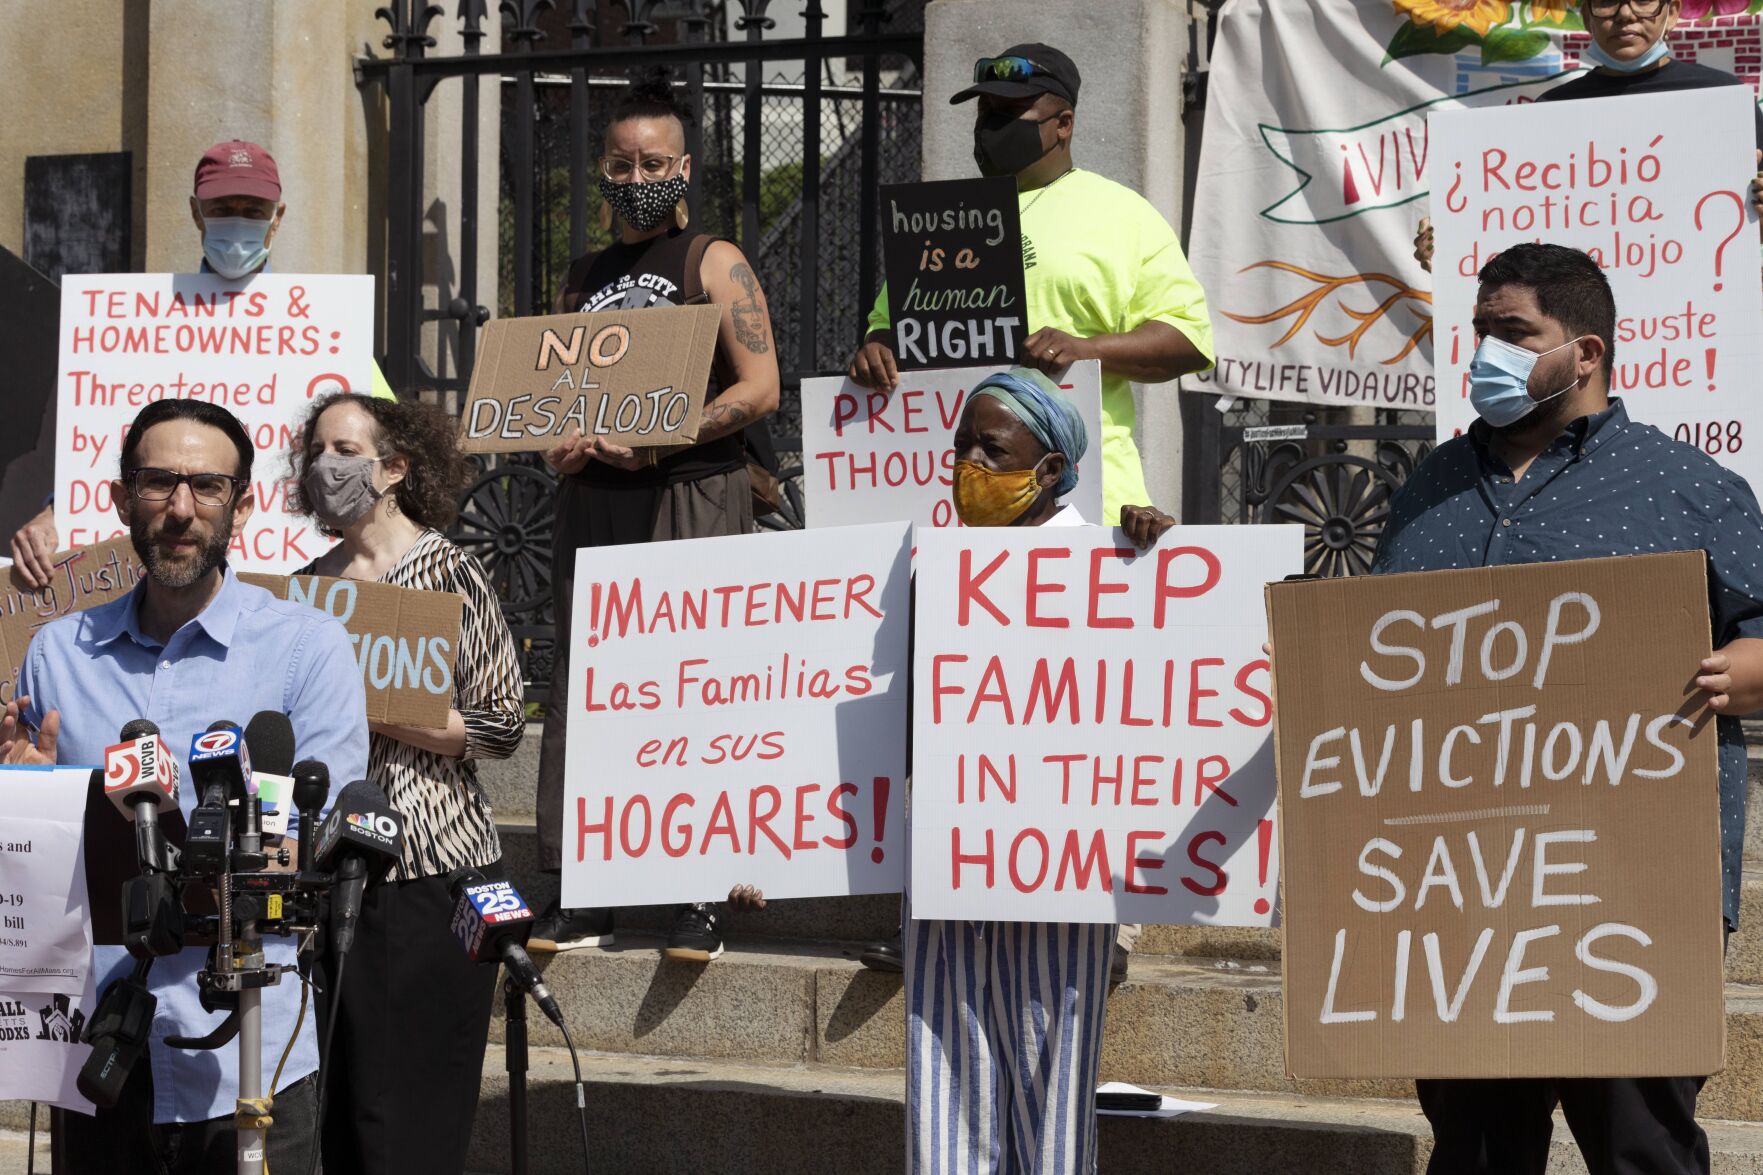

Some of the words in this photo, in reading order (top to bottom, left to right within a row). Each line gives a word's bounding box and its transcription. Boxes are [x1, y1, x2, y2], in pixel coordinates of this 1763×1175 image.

[1340, 118, 1429, 206] ¡VIV
[891, 199, 1004, 245] housing
[1482, 194, 1664, 231] noticia
[920, 240, 945, 272] is
[954, 247, 981, 270] a
[1458, 240, 1500, 277] d
[1537, 232, 1683, 278] alojo
[1694, 190, 1745, 292] ?
[580, 282, 614, 312] GHT
[616, 280, 636, 291] THE
[619, 275, 631, 284] TO
[638, 273, 678, 297] CITY
[902, 278, 1015, 312] human
[82, 289, 269, 319] TENANTS
[287, 285, 311, 319] &
[72, 324, 342, 356] HOMEOWNERS:
[896, 316, 1020, 364] RIGHT
[1613, 301, 1717, 343] suste
[535, 323, 631, 371] NO
[67, 371, 278, 407] Threatened
[551, 367, 600, 392] AL
[1317, 367, 1436, 406] VIDAURB
[467, 386, 690, 439] DESALOJO
[832, 388, 966, 438] PREV
[71, 424, 109, 469] by
[815, 449, 957, 492] THOUS
[225, 526, 309, 562] ACK
[0, 584, 58, 617] ing
[287, 576, 358, 625] NO
[957, 545, 1223, 629] KEEP
[1360, 591, 1601, 691] STOP
[347, 633, 451, 695] IONS
[585, 665, 662, 713] Las
[677, 652, 874, 709] Familias
[932, 654, 1273, 727] FAMILIES
[141, 740, 155, 780] WCVB
[192, 748, 236, 760] NEWS
[635, 735, 689, 768] en
[701, 730, 786, 765] sus
[1300, 704, 1696, 799] EVICTIONS
[957, 753, 1017, 804] IN
[1042, 753, 1239, 807] THEIR
[349, 824, 393, 846] BOSTON
[365, 811, 399, 838] 10
[576, 776, 891, 865] HOGARES!
[7, 841, 32, 853] and
[951, 819, 1274, 915] HOMES!
[1352, 828, 1602, 913] SAVE
[0, 893, 24, 907] -19
[466, 881, 511, 896] BOSTON
[477, 889, 521, 915] 25
[4, 915, 25, 930] bill
[495, 908, 531, 922] NEWS
[1319, 922, 1659, 1024] LIVES
